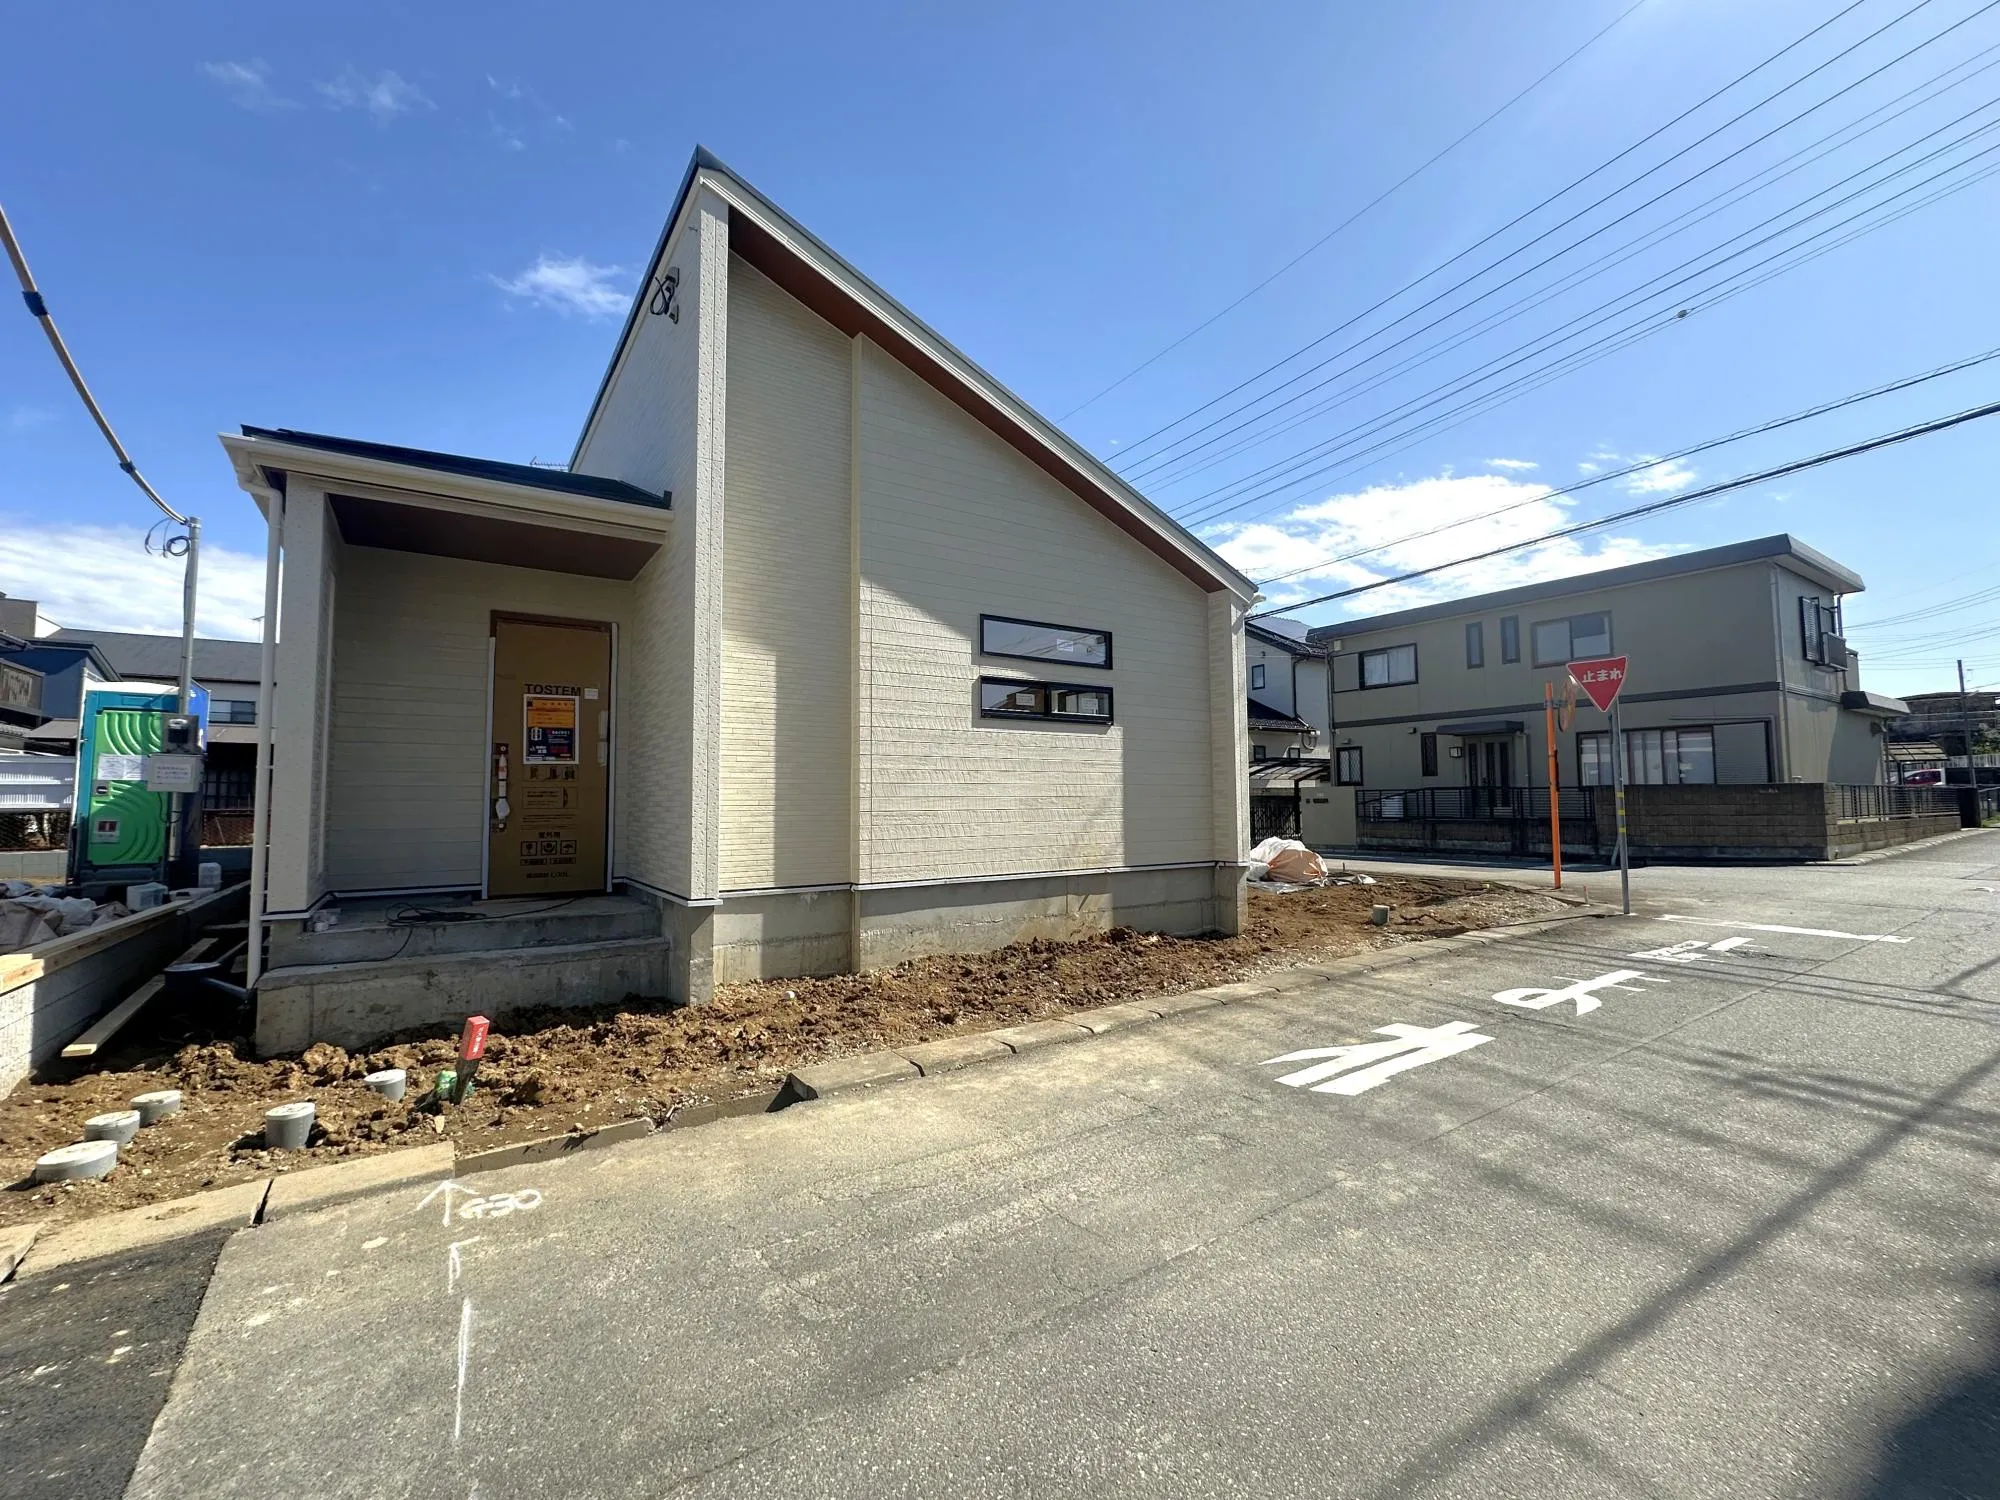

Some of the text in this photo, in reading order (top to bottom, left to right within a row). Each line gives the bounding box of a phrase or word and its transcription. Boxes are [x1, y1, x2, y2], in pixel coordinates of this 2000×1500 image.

[1582, 668, 1622, 683] 止まれ
[524, 684, 581, 696] TOSTEM
